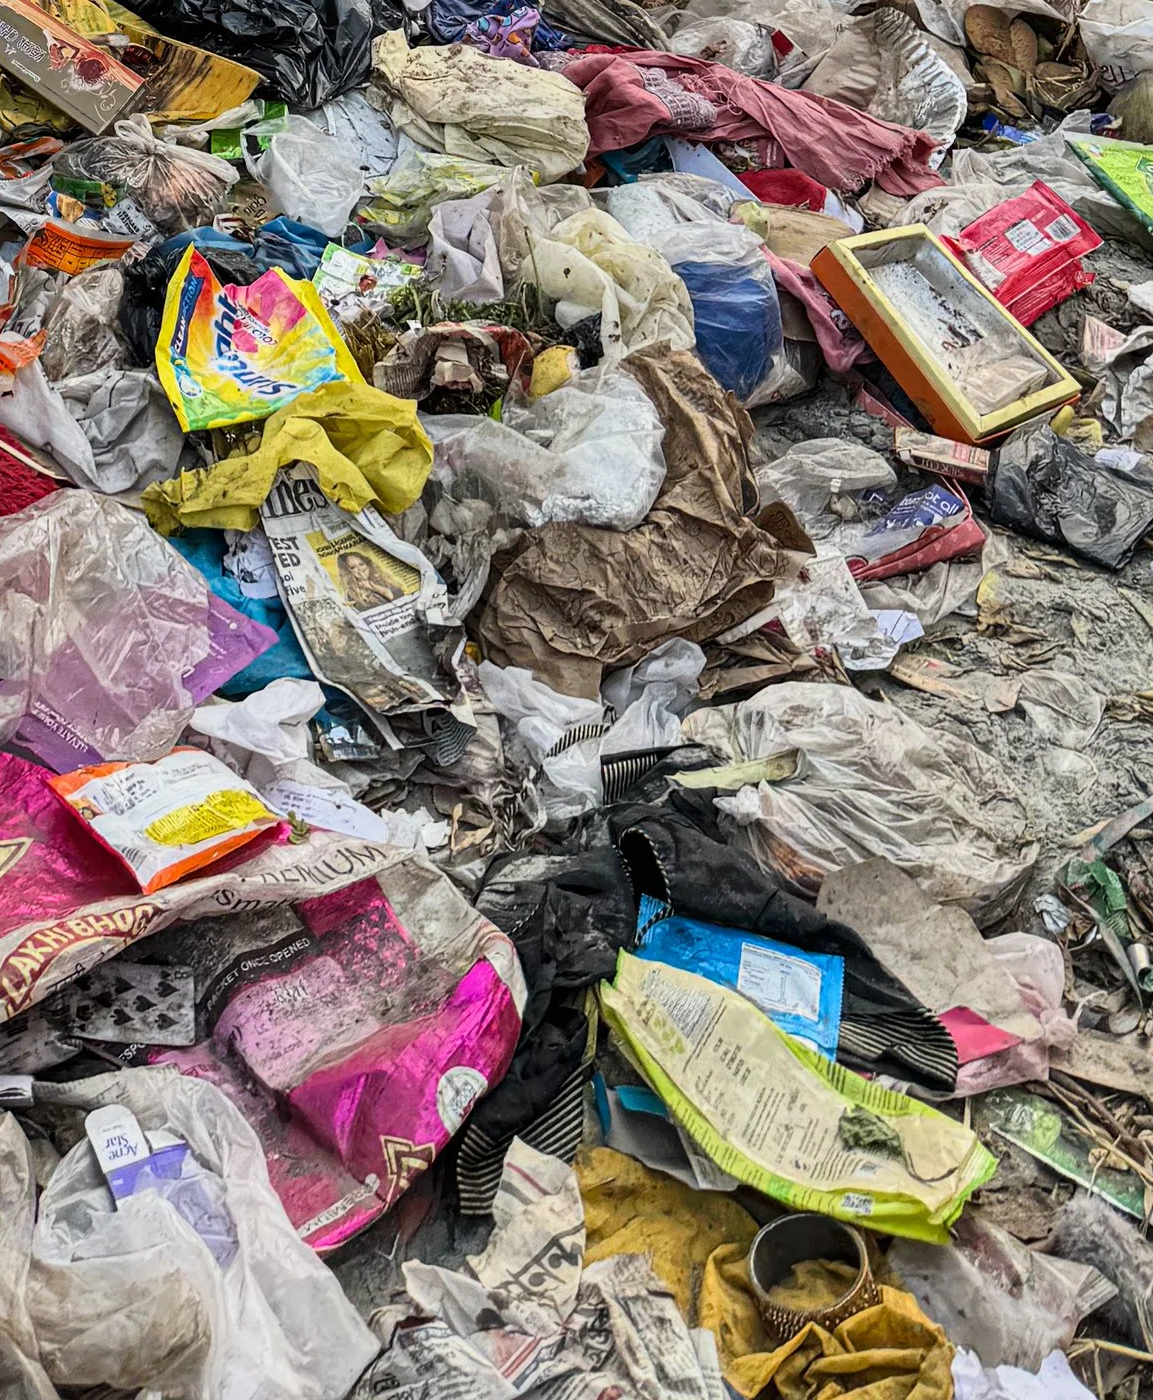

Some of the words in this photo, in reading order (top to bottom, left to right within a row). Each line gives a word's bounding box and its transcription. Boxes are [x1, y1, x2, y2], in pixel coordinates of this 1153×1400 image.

[275, 552, 301, 568] ED
[269, 936, 311, 963] OPENED
[104, 1133, 130, 1149] Star
[108, 1141, 138, 1162] Acne
